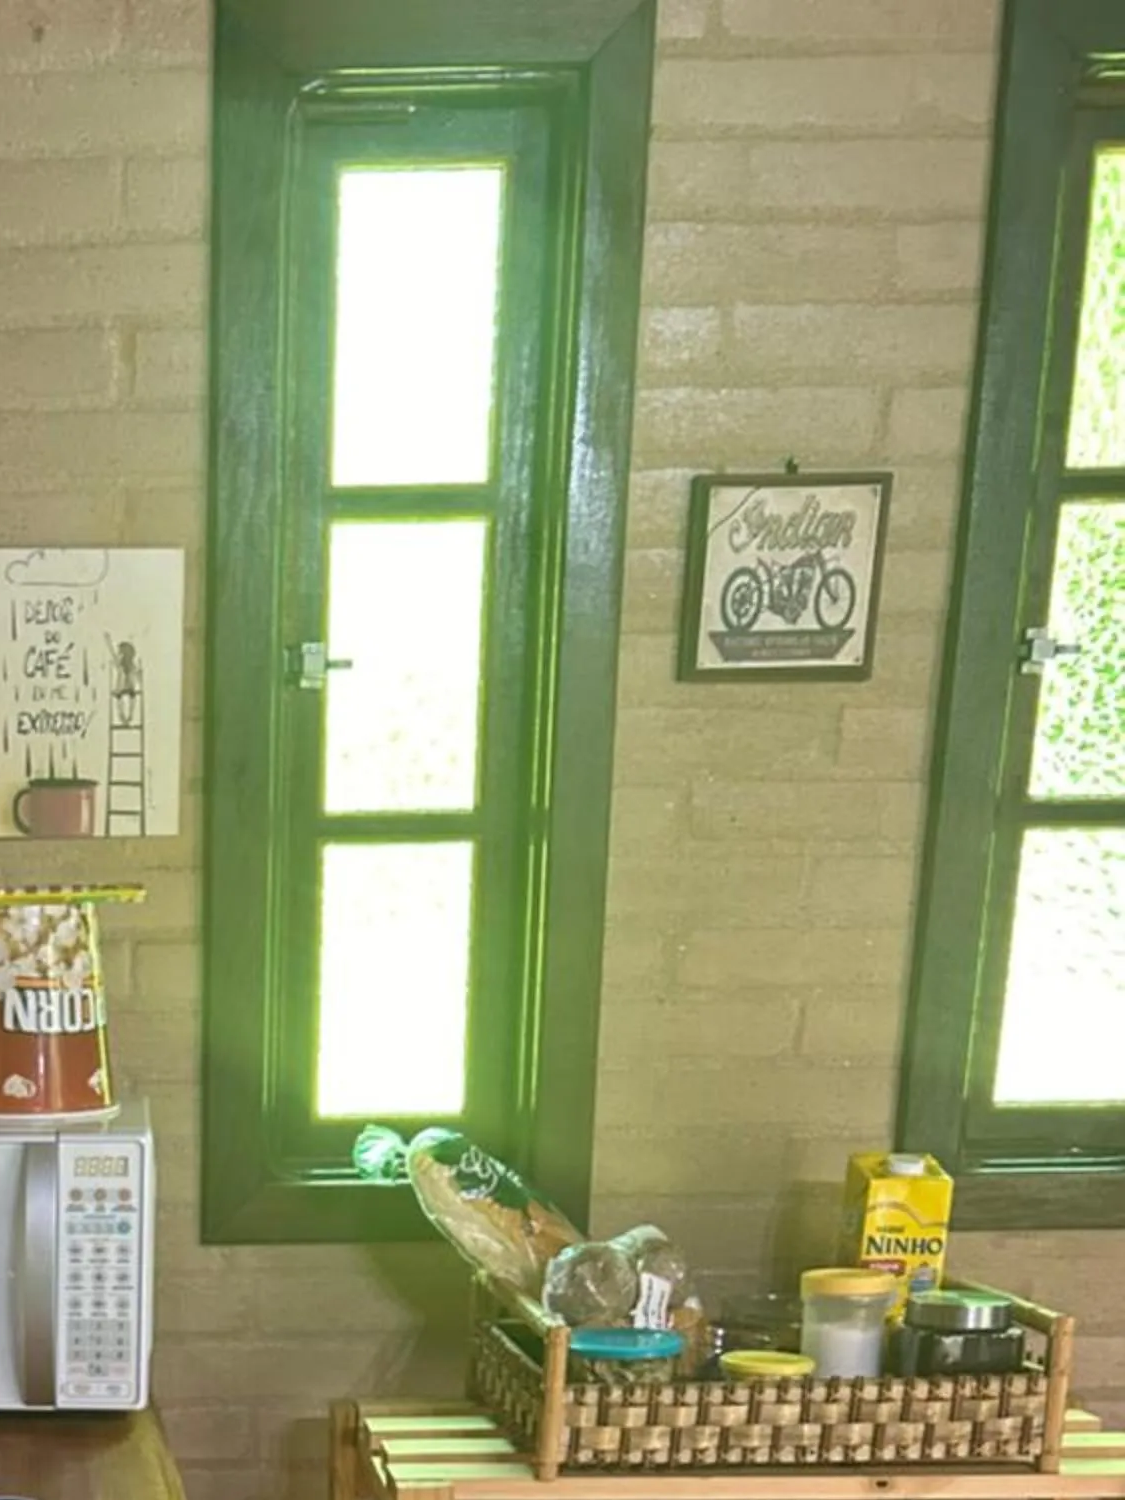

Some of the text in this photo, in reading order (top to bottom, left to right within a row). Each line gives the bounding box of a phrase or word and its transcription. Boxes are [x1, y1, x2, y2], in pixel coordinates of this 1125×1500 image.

[24, 643, 74, 679] CAFÉ
[2, 987, 96, 1033] CORN
[865, 1236, 944, 1256] NINHO
